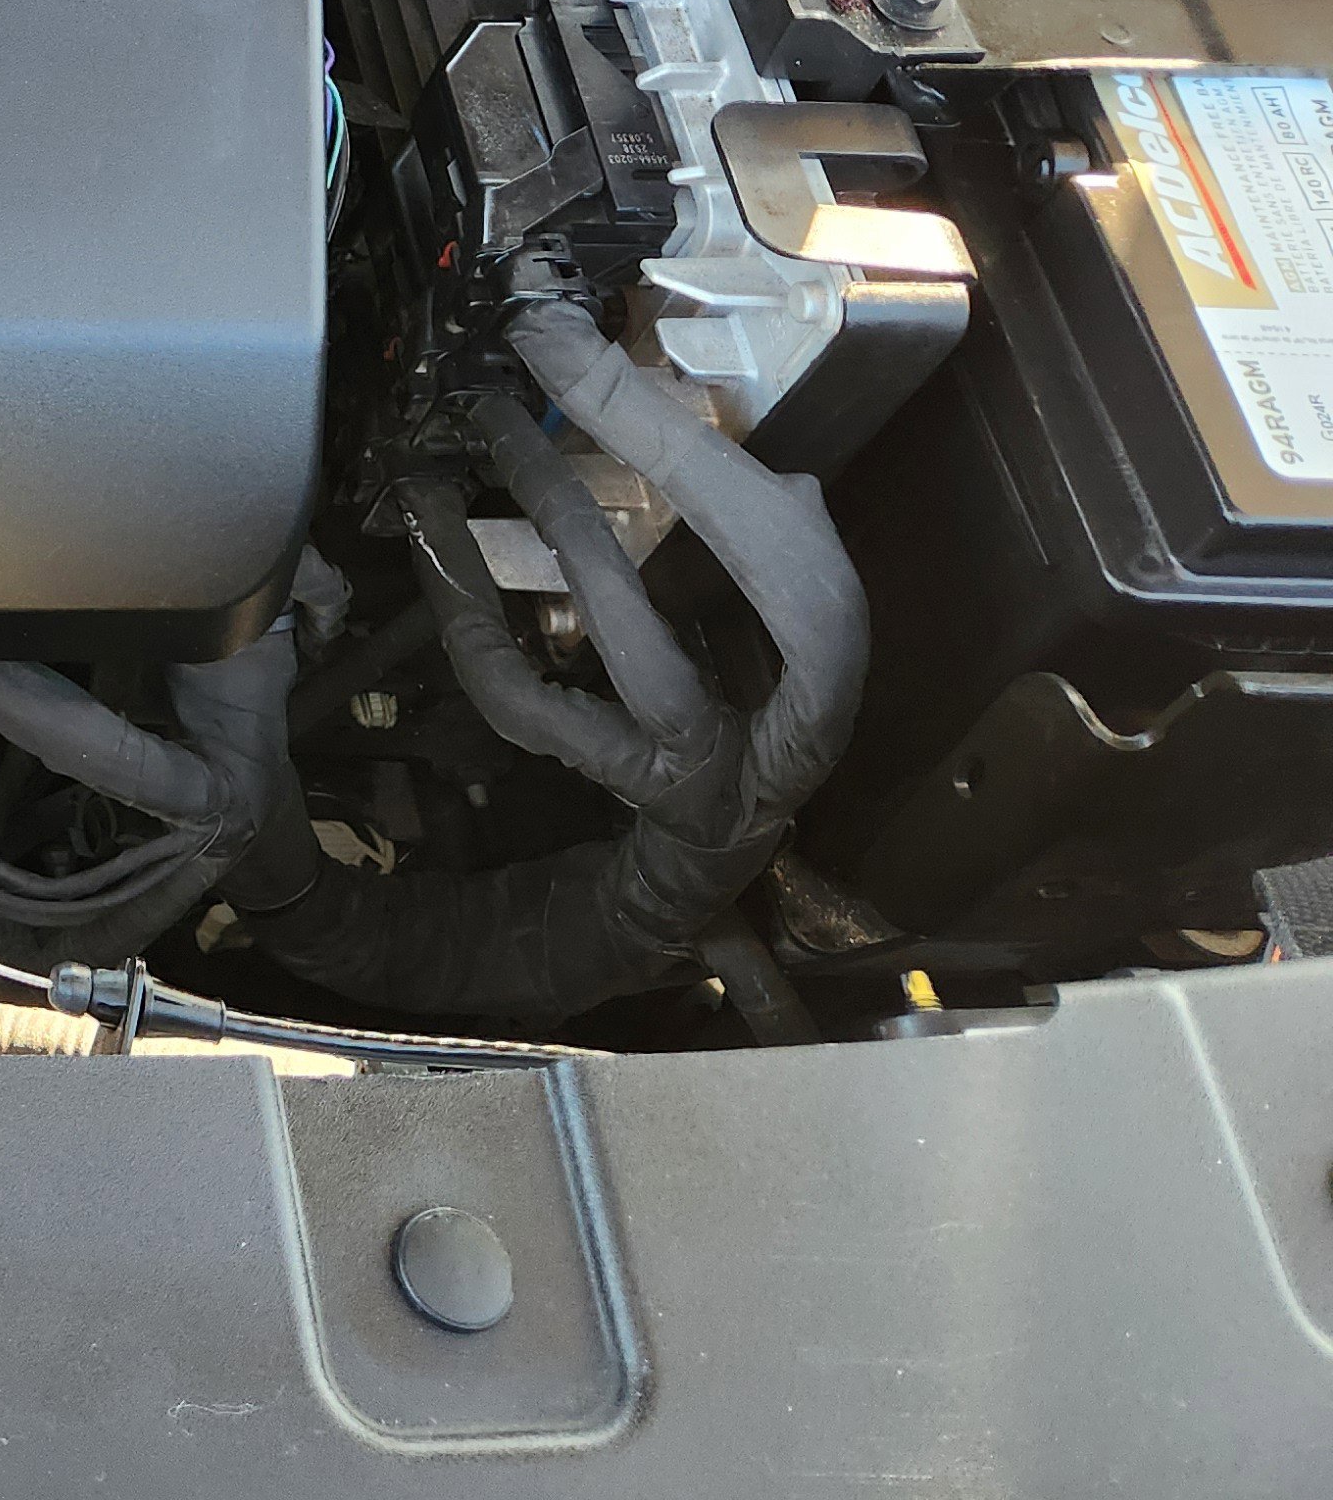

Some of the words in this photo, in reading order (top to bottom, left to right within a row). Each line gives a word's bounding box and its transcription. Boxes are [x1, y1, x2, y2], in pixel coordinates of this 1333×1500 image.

[1204, 103, 1230, 138] FREE
[1223, 78, 1275, 170] MANTENIMIENT
[1278, 121, 1296, 138] 80
[1270, 175, 1285, 190] DE
[1296, 157, 1313, 174] RC
[1223, 144, 1284, 252] MAINTENANCE
[1264, 192, 1287, 224] SANS
[1308, 180, 1331, 206] 140
[1280, 197, 1306, 233] LIBRE
[1282, 230, 1319, 292] BATTERIE
[1238, 360, 1305, 464] 94RAGM
